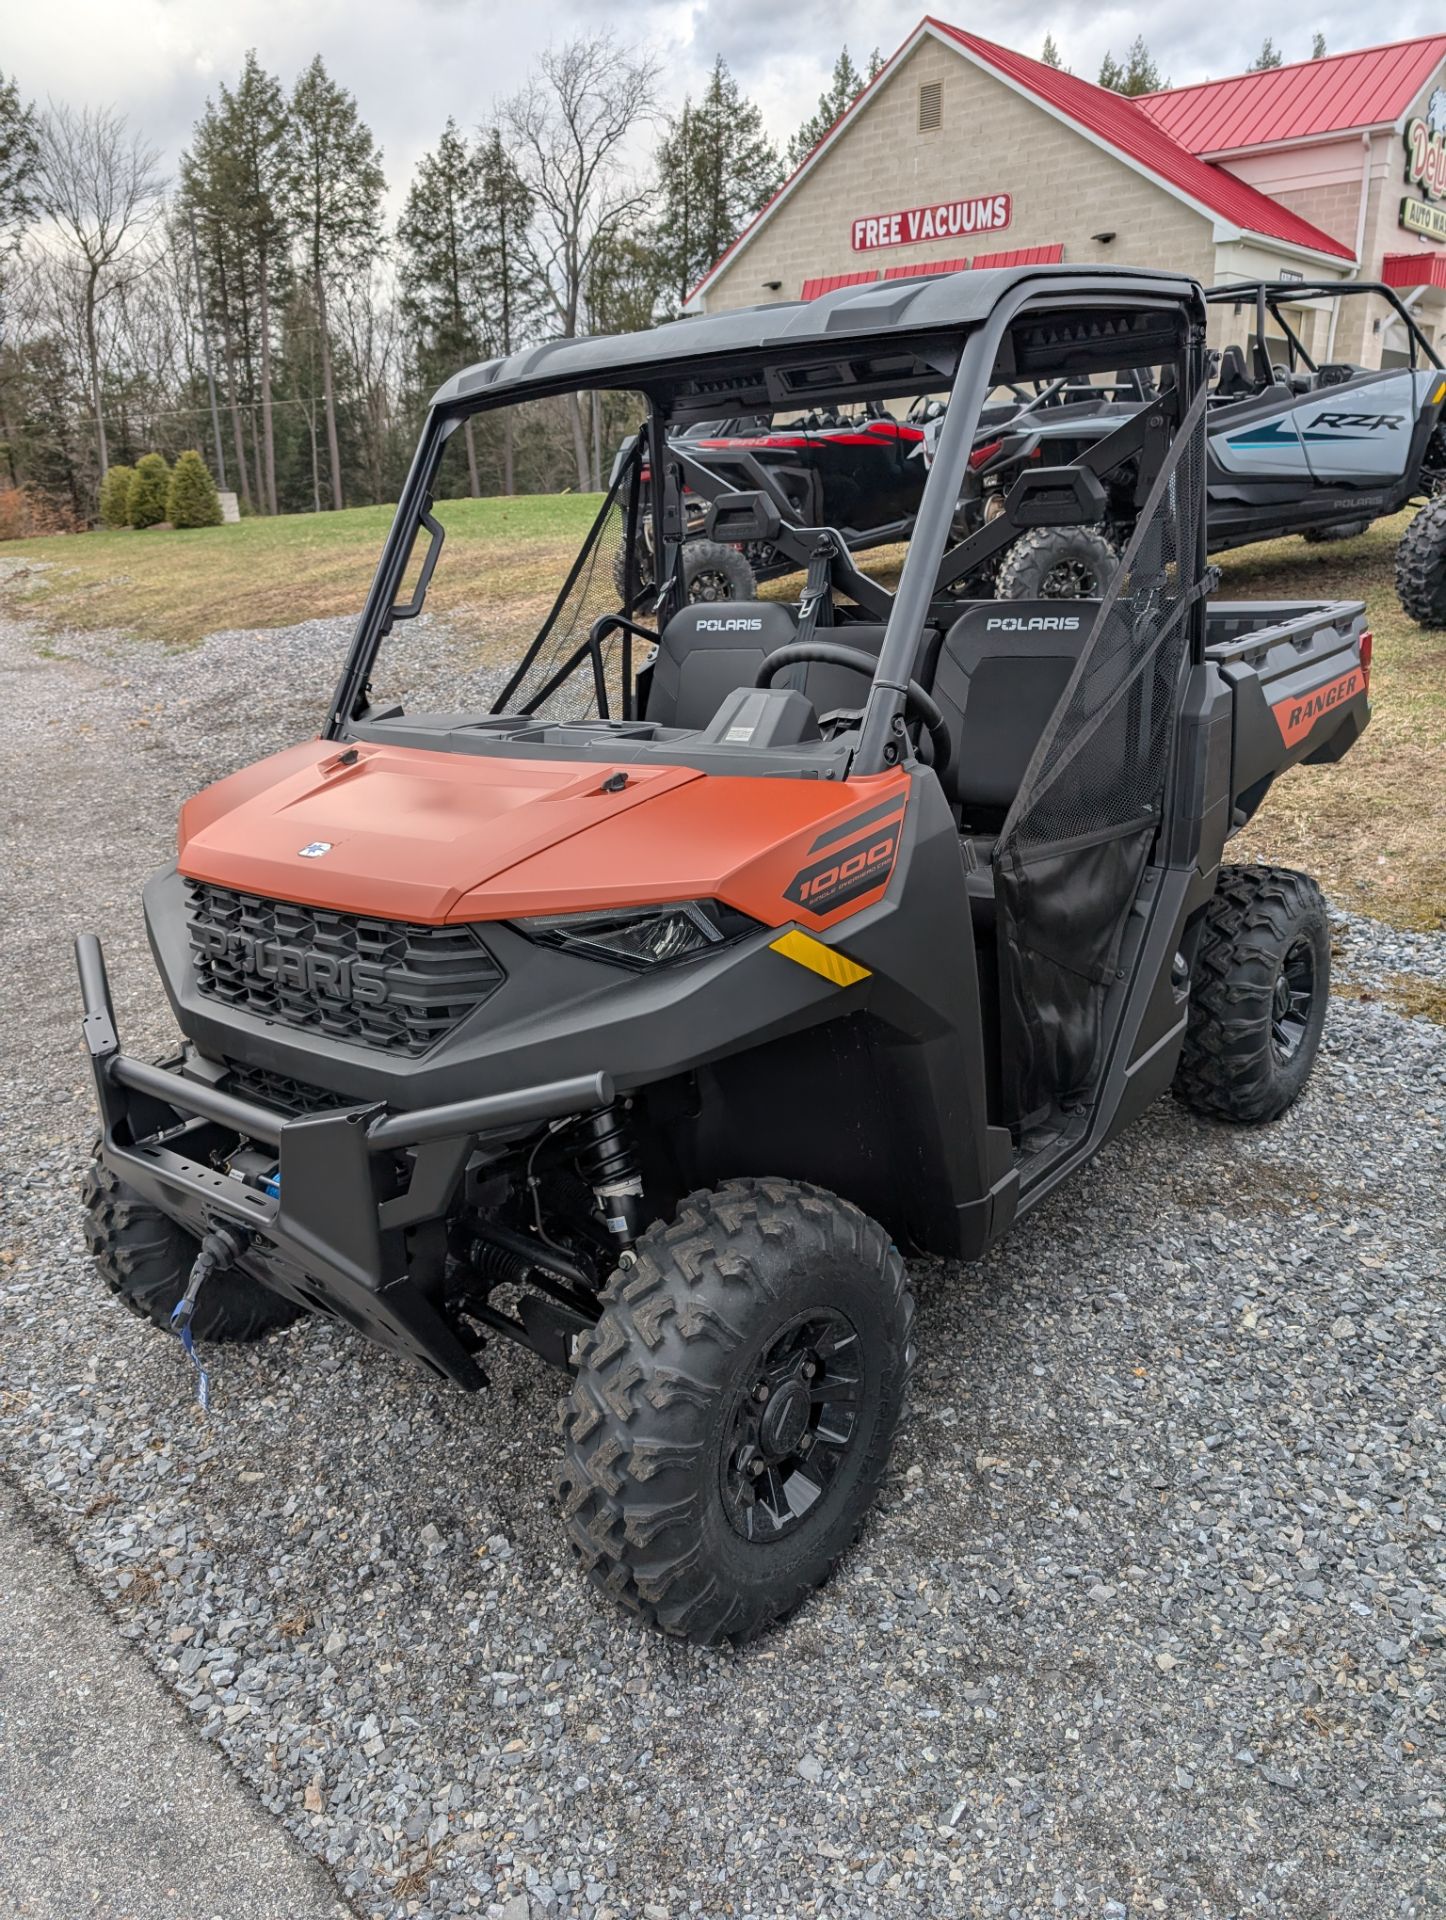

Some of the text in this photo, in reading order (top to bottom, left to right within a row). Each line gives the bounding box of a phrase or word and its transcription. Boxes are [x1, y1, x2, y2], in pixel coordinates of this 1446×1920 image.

[855, 196, 1007, 249] FREE VACUUMS
[1409, 203, 1446, 233] AUTO WA
[1306, 412, 1406, 432] RZR
[696, 618, 763, 632] POLARIS
[986, 616, 1080, 632] POLARIS
[1288, 675, 1357, 730] RANGER
[800, 838, 893, 901] 1000
[203, 924, 389, 1004] POLARIS
